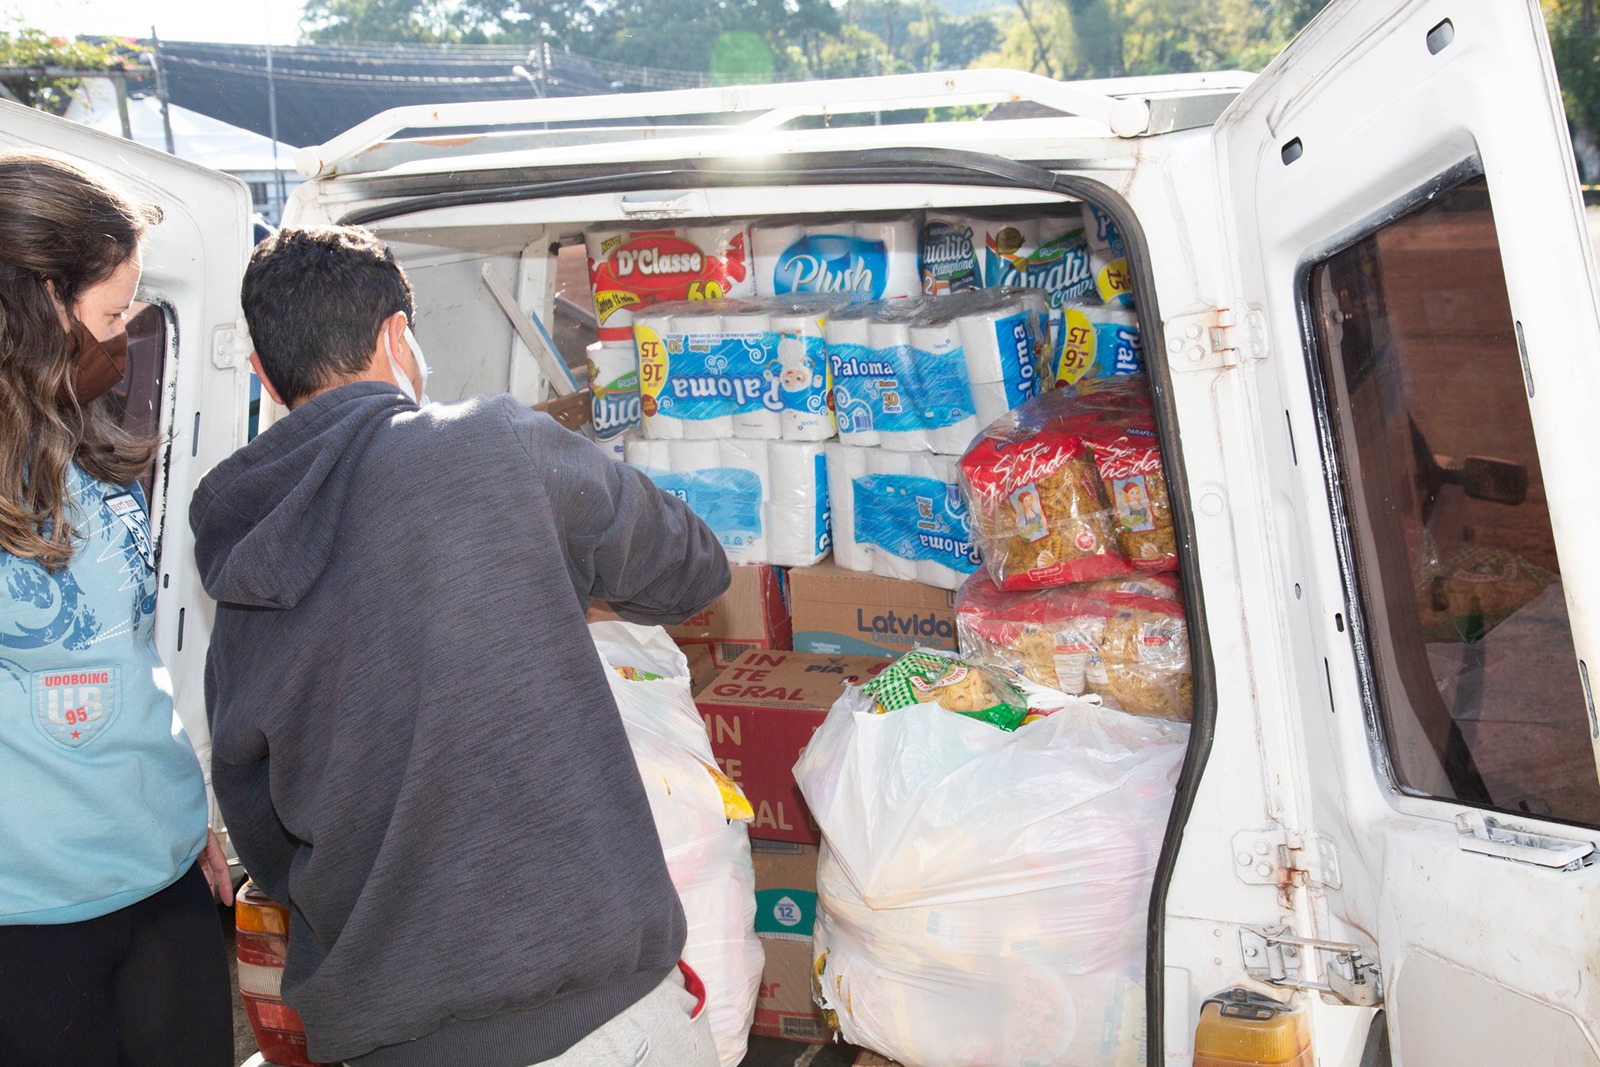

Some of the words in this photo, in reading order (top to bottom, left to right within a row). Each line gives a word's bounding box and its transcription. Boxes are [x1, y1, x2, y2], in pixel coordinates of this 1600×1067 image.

[923, 229, 972, 264] ualité
[616, 246, 702, 276] D'Classe
[932, 258, 975, 276] Campione
[784, 254, 873, 293] Plush
[1051, 278, 1094, 308] Campi
[1068, 327, 1090, 345] 15
[641, 342, 659, 358] 15
[830, 354, 894, 377] Paloma
[1063, 349, 1089, 370] 16
[643, 364, 663, 382] 16
[671, 377, 784, 411] Paloma
[882, 393, 899, 406] 30
[919, 534, 982, 564] Paloma
[857, 608, 953, 638] Latvida
[743, 653, 787, 668] IN
[804, 663, 849, 674] PIÁ
[45, 672, 109, 687] UDOBOING
[731, 667, 771, 682] TE
[712, 683, 805, 701] GRAL
[48, 686, 104, 725] UB
[65, 707, 87, 725] 95
[778, 906, 794, 918] 12
